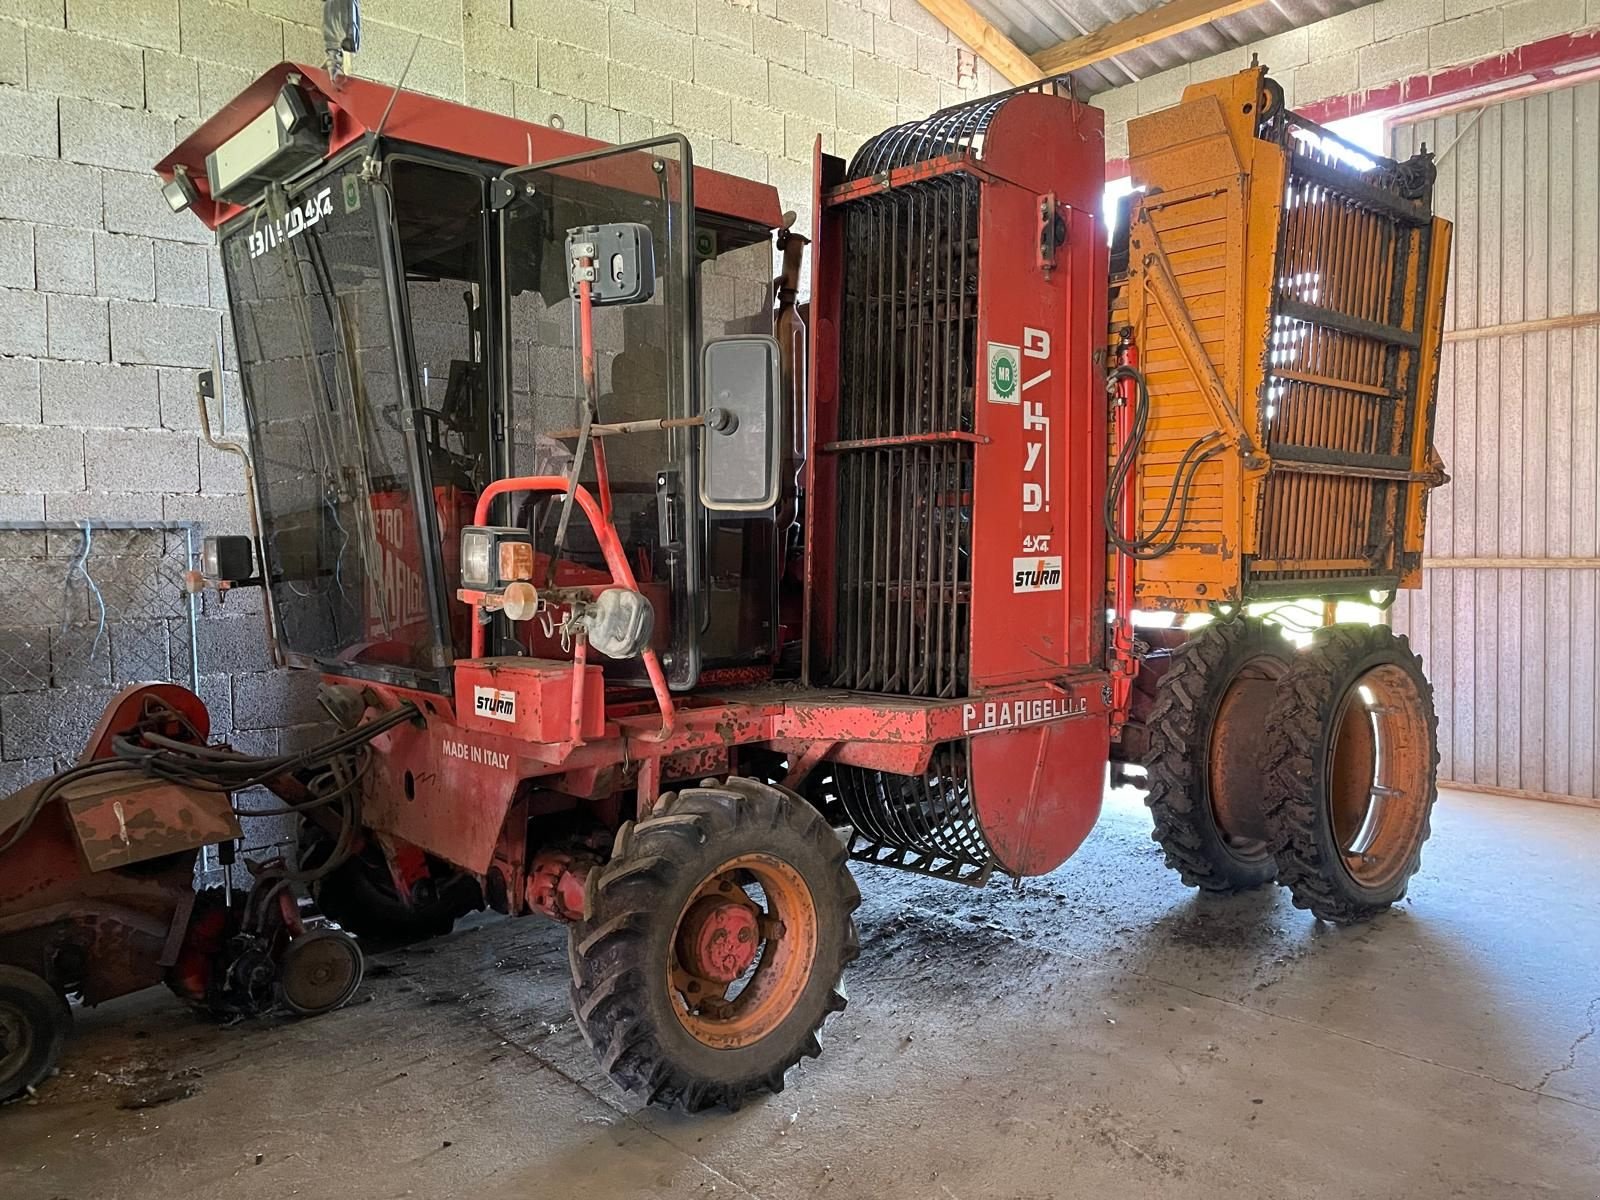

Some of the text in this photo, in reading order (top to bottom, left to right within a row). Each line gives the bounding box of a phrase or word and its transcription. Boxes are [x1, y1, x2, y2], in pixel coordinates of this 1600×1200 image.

[998, 367, 1011, 381] MR
[1015, 569, 1060, 587] STURM
[476, 695, 514, 715] STURM
[442, 739, 510, 770] MADE IN ITALY
